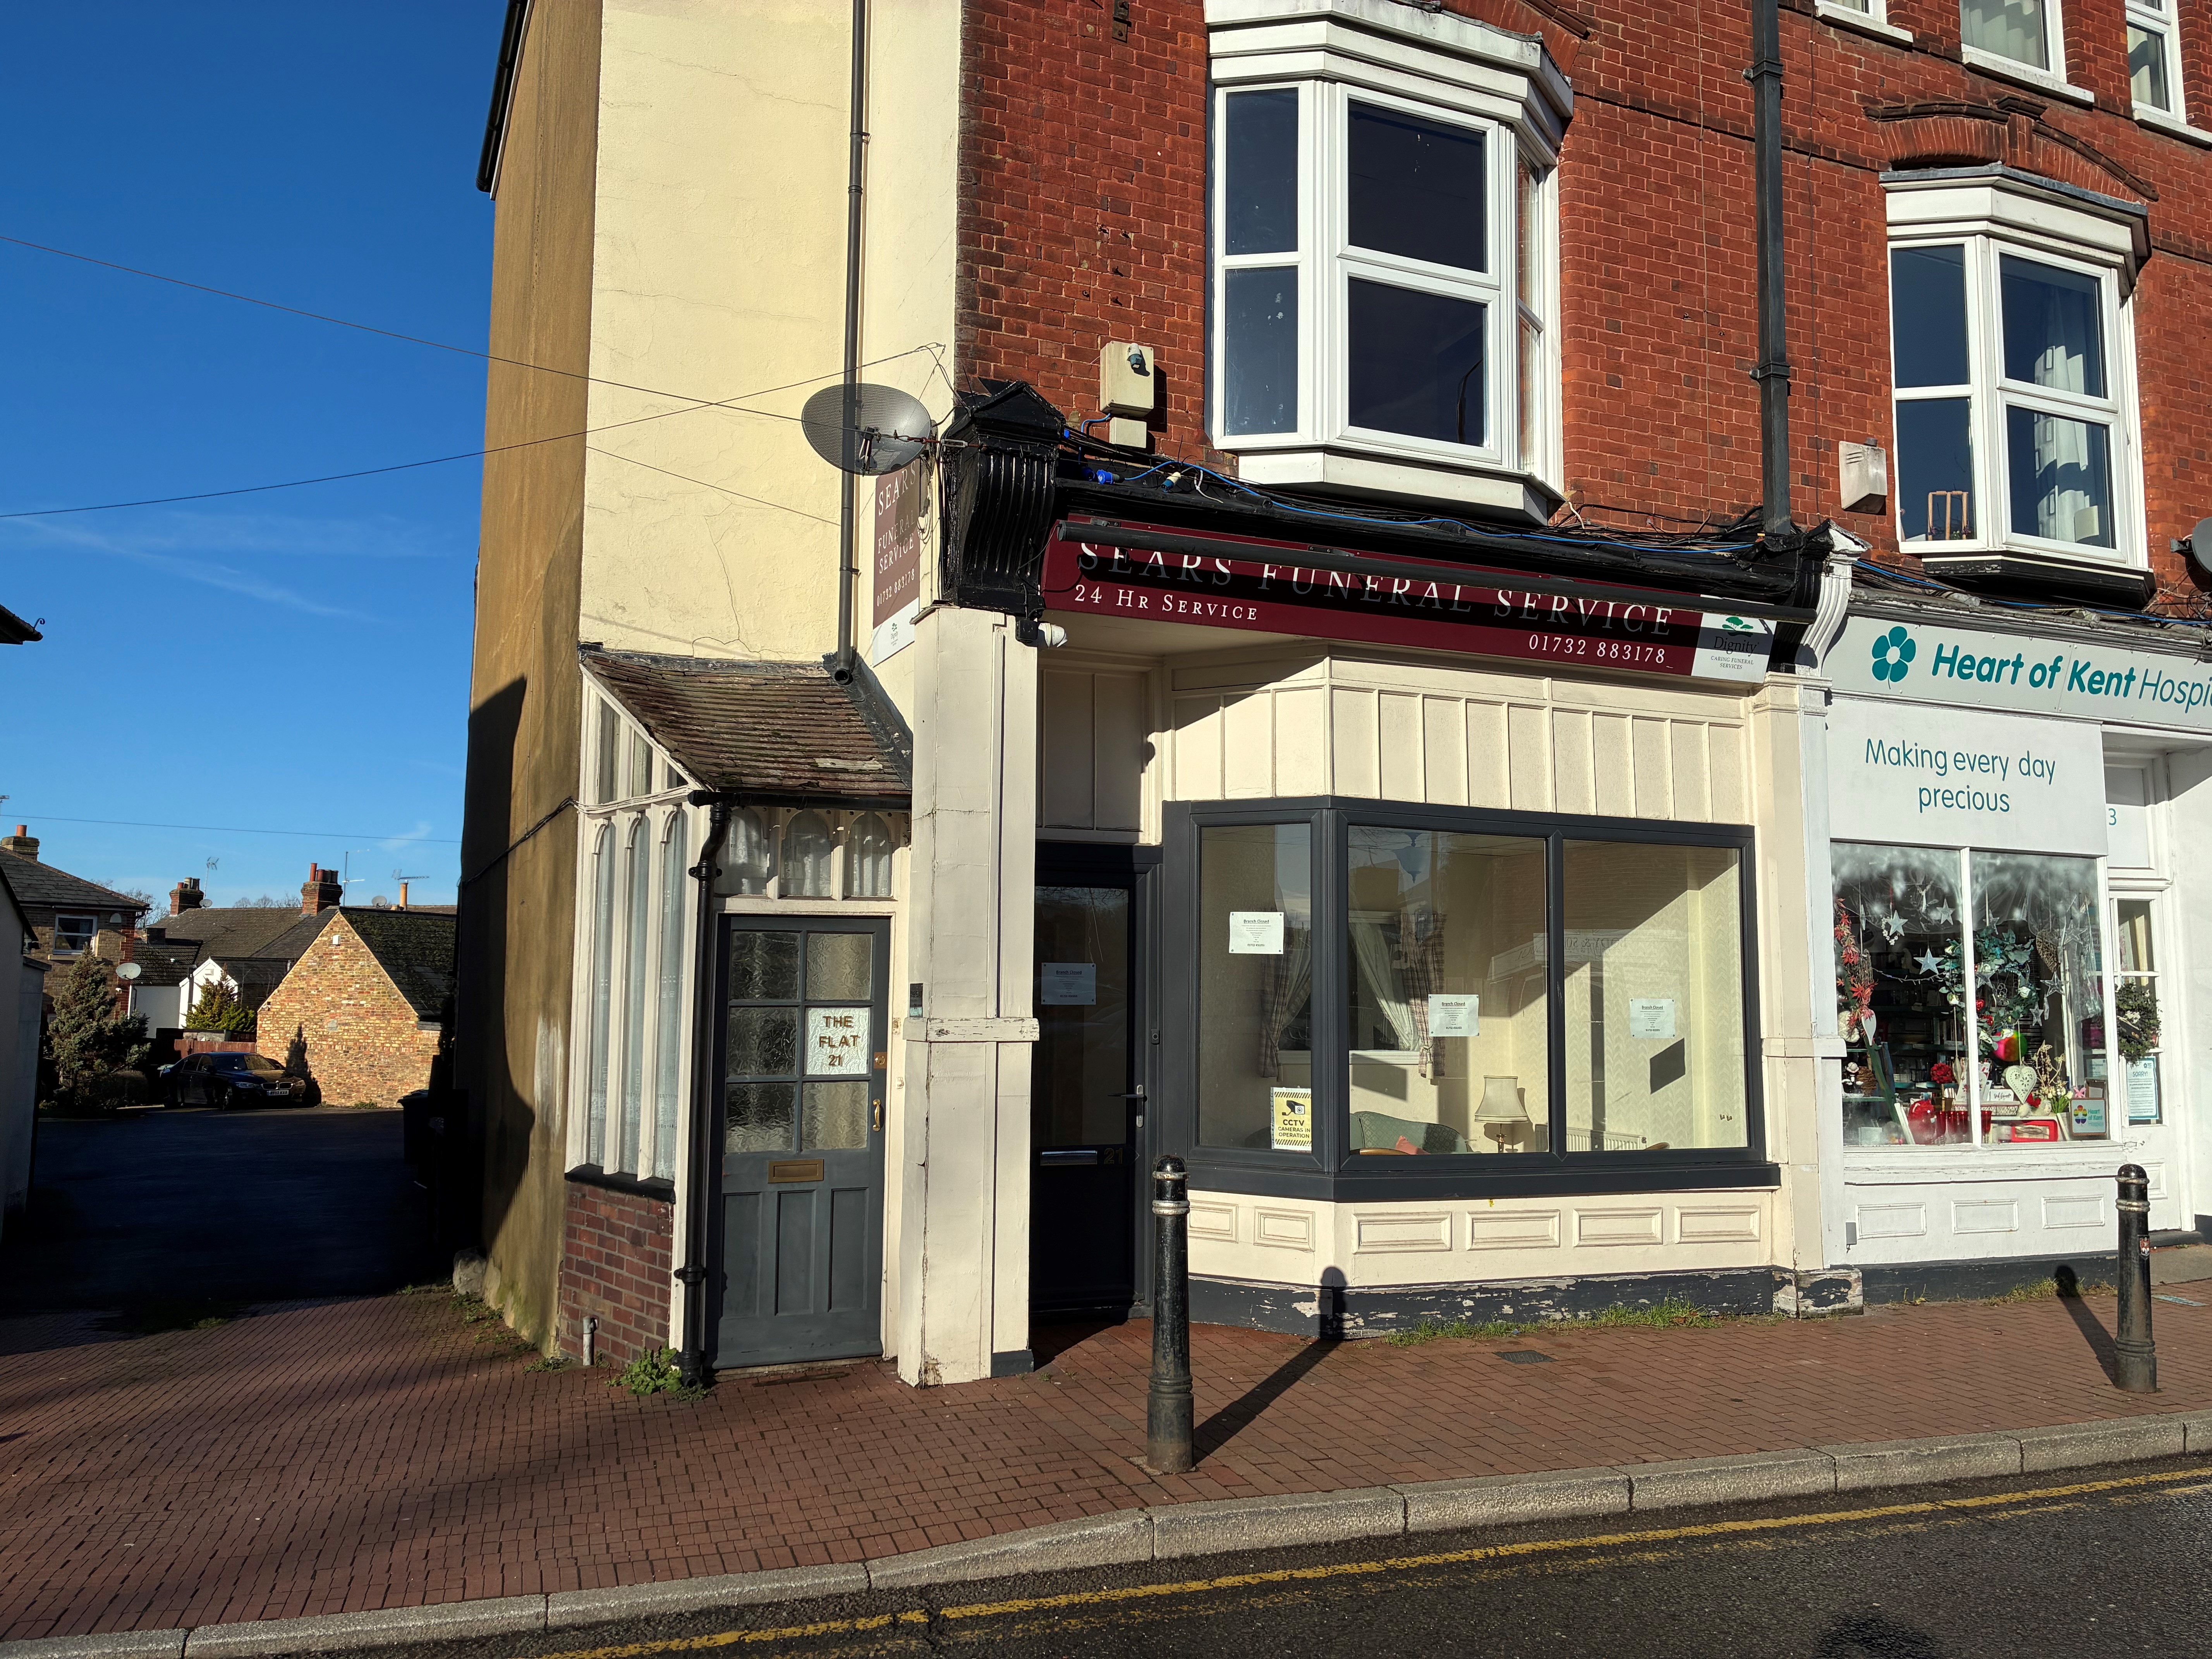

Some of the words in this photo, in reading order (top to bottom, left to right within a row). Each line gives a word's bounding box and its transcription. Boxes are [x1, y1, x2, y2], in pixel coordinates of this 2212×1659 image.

[879, 460, 915, 517] SEARS
[878, 510, 915, 554] FUNERAL
[879, 533, 914, 574] SERVICE
[877, 586, 892, 607] 01732
[894, 568, 914, 594] 883178
[1075, 584, 1102, 604] 24
[1078, 542, 1231, 585] SEARS
[1258, 563, 1471, 612] FUNERAL
[1494, 589, 1672, 635] SERVICE
[1529, 634, 1586, 655] 01732
[1597, 642, 1665, 664] 883178
[1714, 636, 1758, 657] Dignity
[1932, 643, 2024, 685] Heart
[2029, 655, 2063, 689] of
[2067, 660, 2136, 699] Kent
[2138, 668, 2212, 714] Hospi
[1865, 738, 1947, 777] Making
[1954, 752, 2009, 781] every
[2019, 750, 2056, 785] day
[1918, 785, 2010, 813] precious
[823, 1016, 854, 1028] THE
[819, 1035, 860, 1048] FLAT
[828, 1054, 842, 1066] 21
[1104, 1147, 1123, 1165] 21
